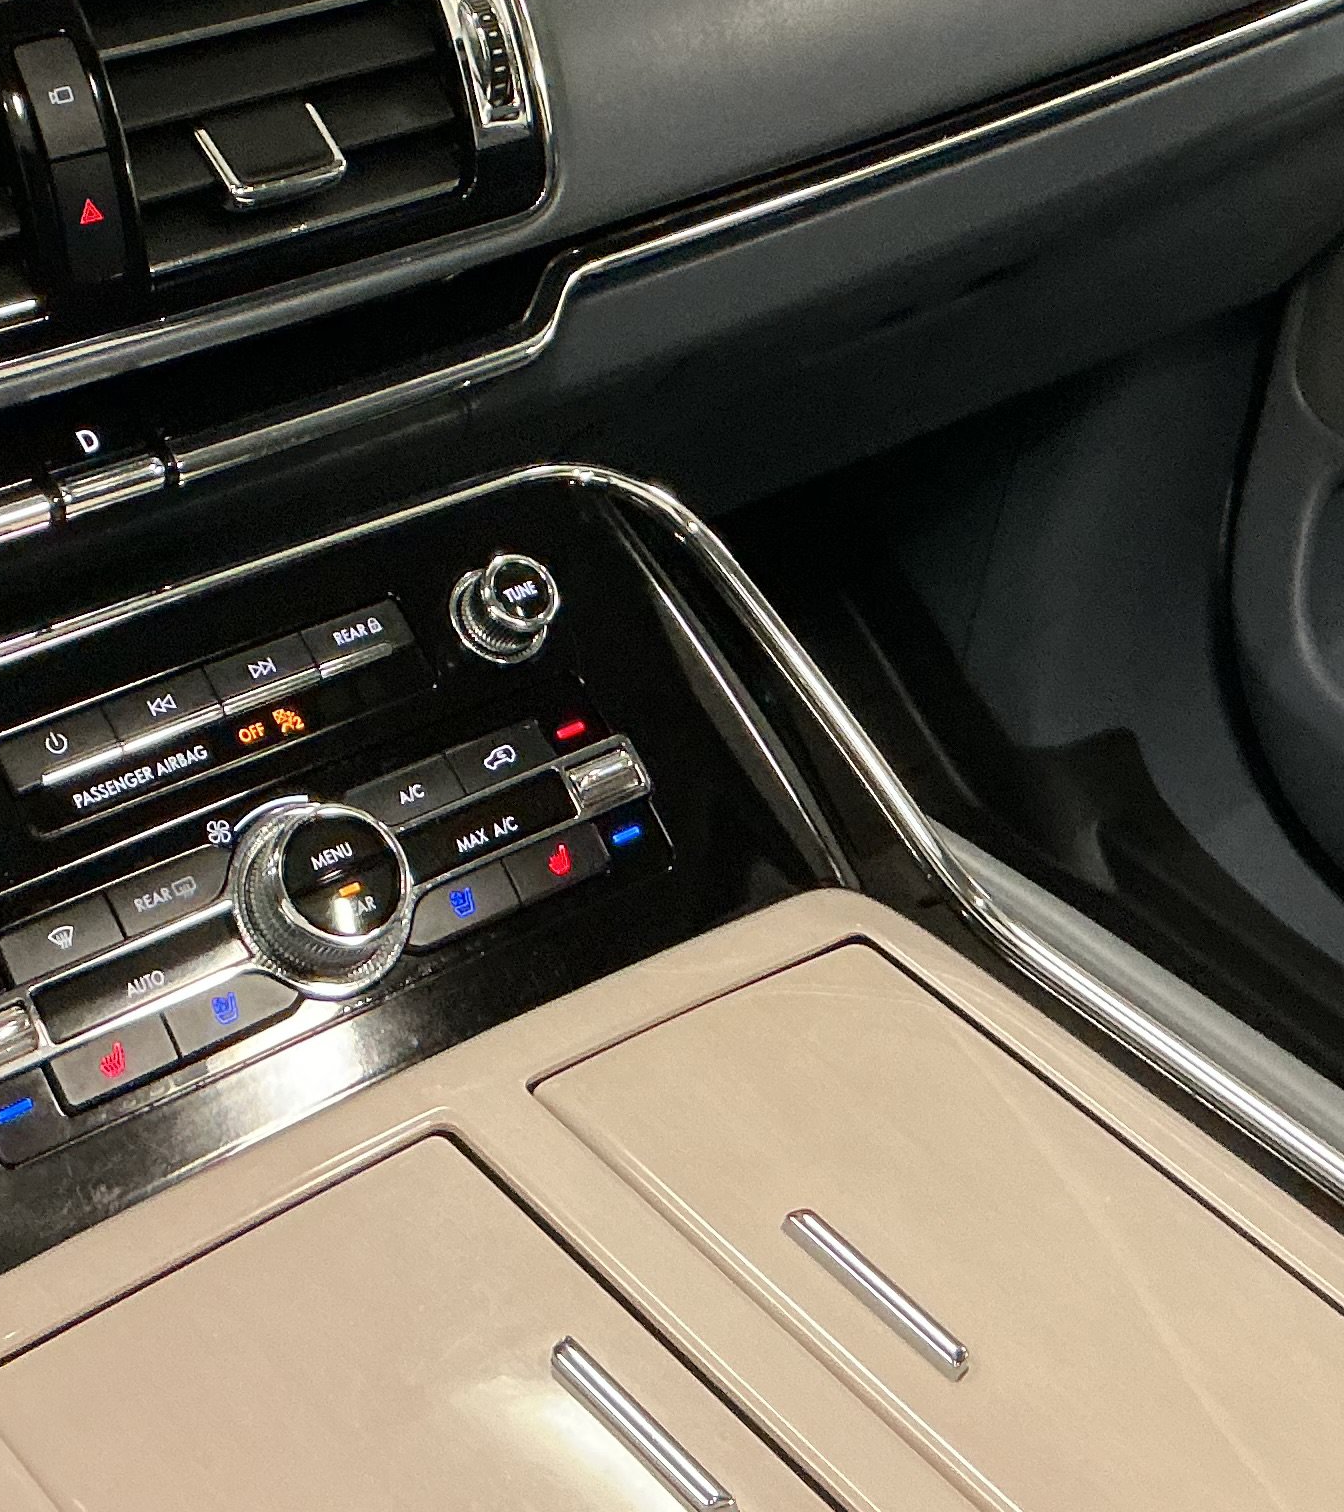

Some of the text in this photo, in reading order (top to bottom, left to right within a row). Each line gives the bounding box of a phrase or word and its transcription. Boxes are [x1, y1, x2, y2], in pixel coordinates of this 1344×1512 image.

[76, 429, 100, 454] D
[502, 579, 538, 605] TUNE
[333, 623, 368, 648] REAR
[237, 721, 266, 744] OFF
[72, 745, 208, 809] PASSENGER AIRBAG
[398, 782, 426, 806] A/C
[455, 814, 519, 854] MAX A/C
[310, 841, 353, 871] MENU
[134, 885, 173, 914] REAR
[126, 968, 166, 999] AUTO
